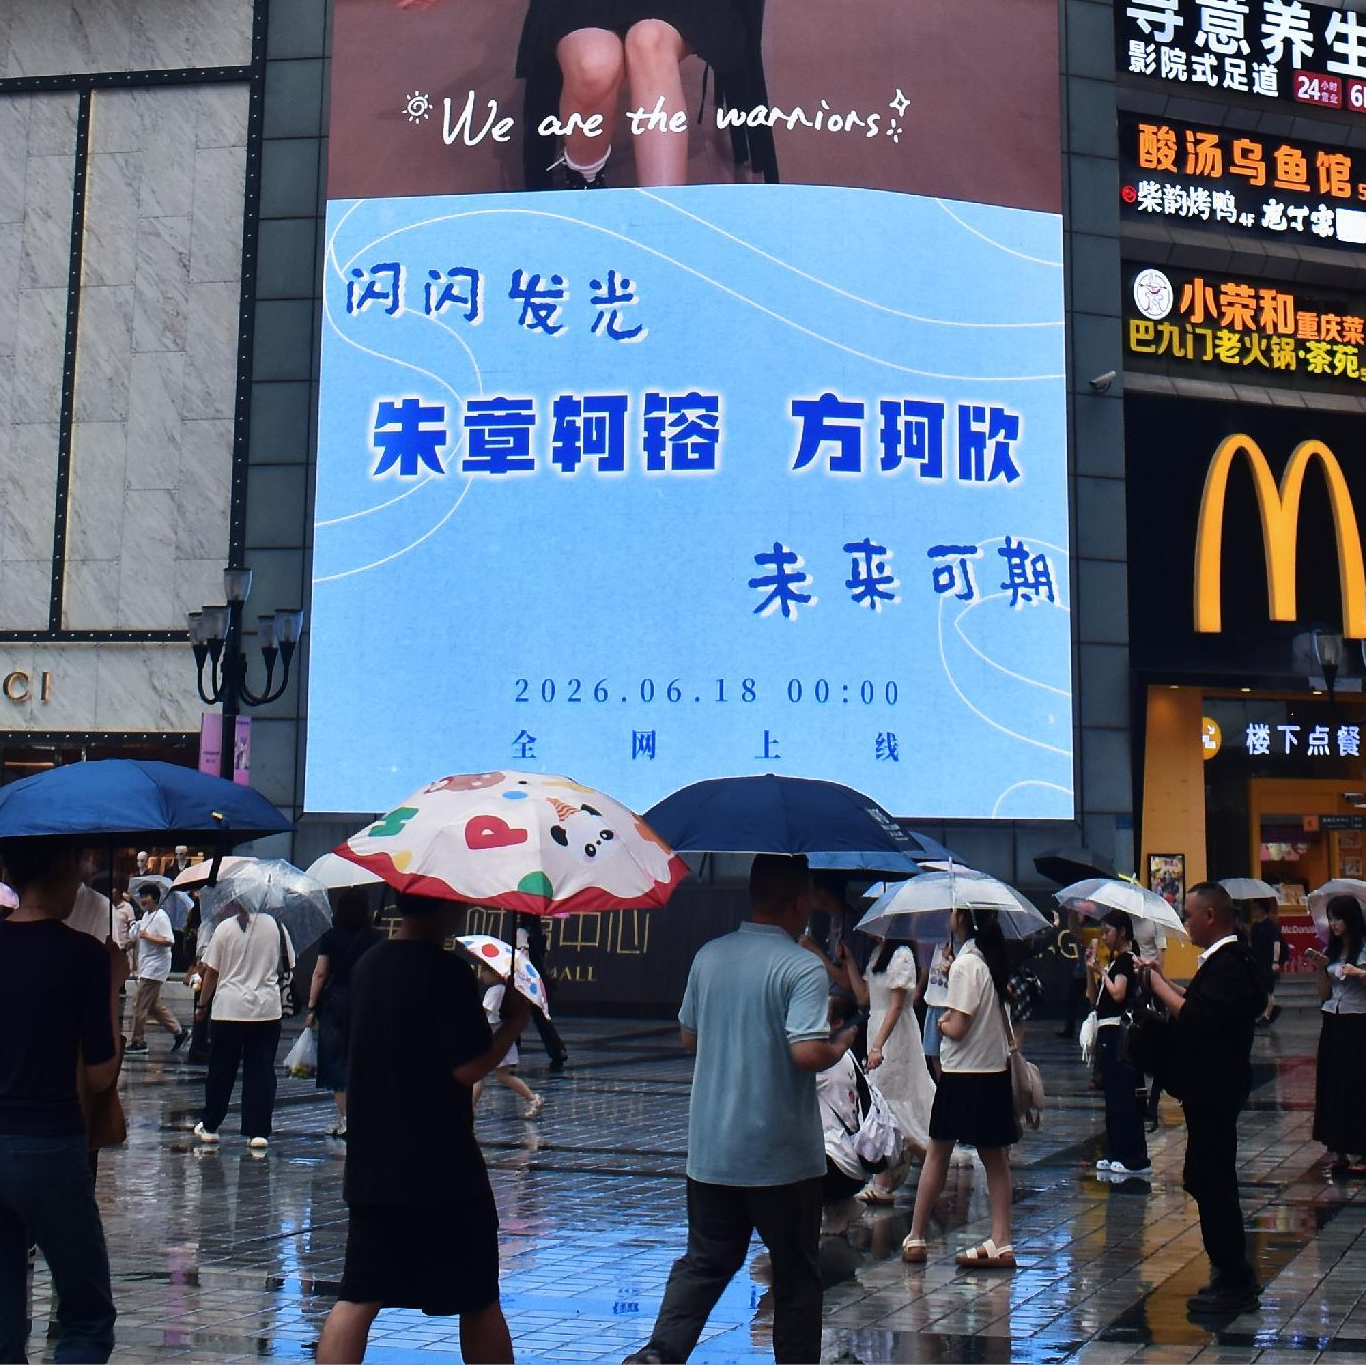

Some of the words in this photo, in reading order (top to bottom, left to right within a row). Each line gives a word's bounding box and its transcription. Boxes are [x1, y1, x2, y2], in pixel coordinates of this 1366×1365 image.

[1128, 39, 1280, 98] 影院式足道
[1297, 74, 1321, 100] 24
[442, 90, 512, 147] We
[537, 109, 604, 139] are
[626, 95, 688, 135] the
[1137, 123, 1353, 199] 酸汤乌鱼馆
[1238, 212, 1255, 228] 4F
[346, 262, 644, 342] 闪闪发光
[1180, 277, 1295, 335] 小荣和
[1296, 311, 1365, 345] 重庆菜
[371, 391, 721, 477] 朱章轲镕
[790, 392, 1021, 484] 方珂欣
[748, 537, 1059, 617] 未来可期
[513, 676, 759, 705] 2026.06.18
[786, 677, 901, 707] 00:00
[511, 729, 901, 763] 全网上线
[1245, 722, 1362, 758] 楼下点餐
